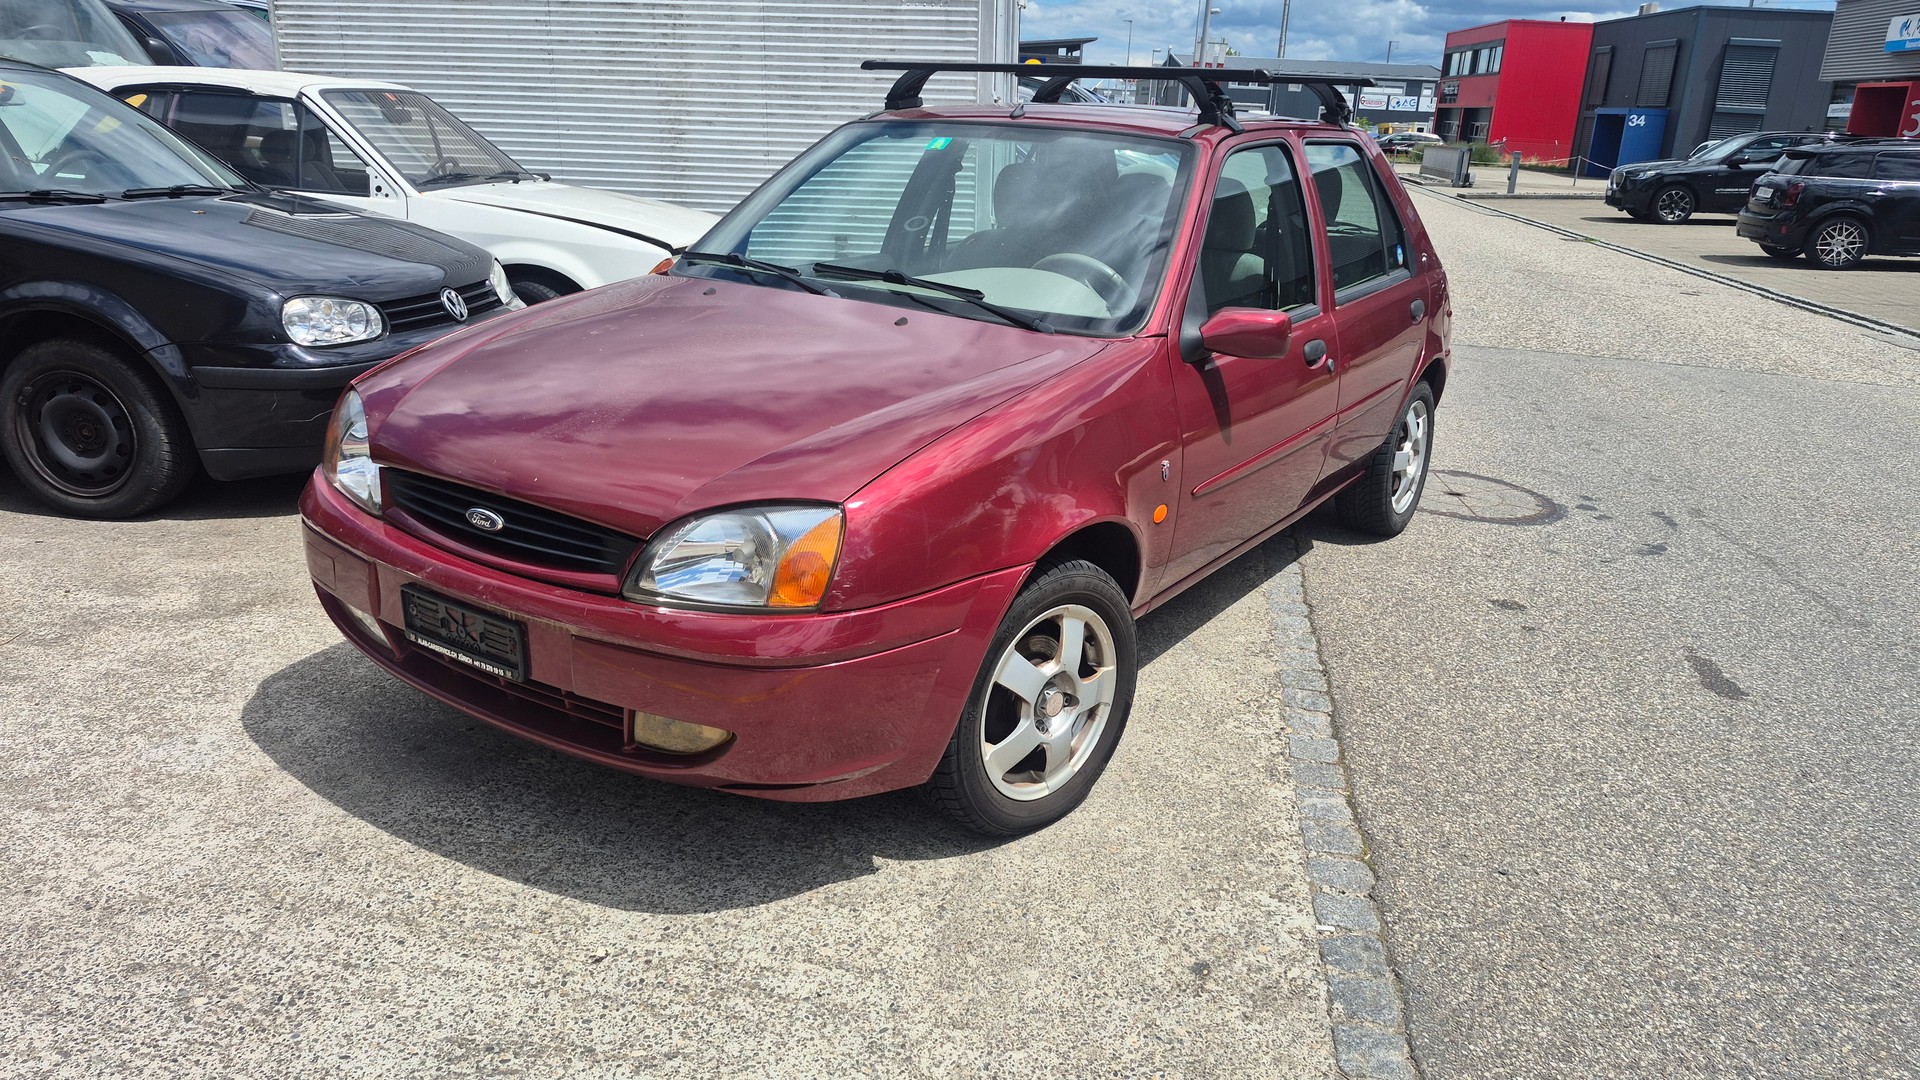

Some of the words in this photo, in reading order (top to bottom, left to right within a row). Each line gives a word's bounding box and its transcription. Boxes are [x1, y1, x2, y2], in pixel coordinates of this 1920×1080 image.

[1628, 114, 1646, 127] 34
[442, 288, 468, 321] VW
[471, 512, 492, 528] Ford
